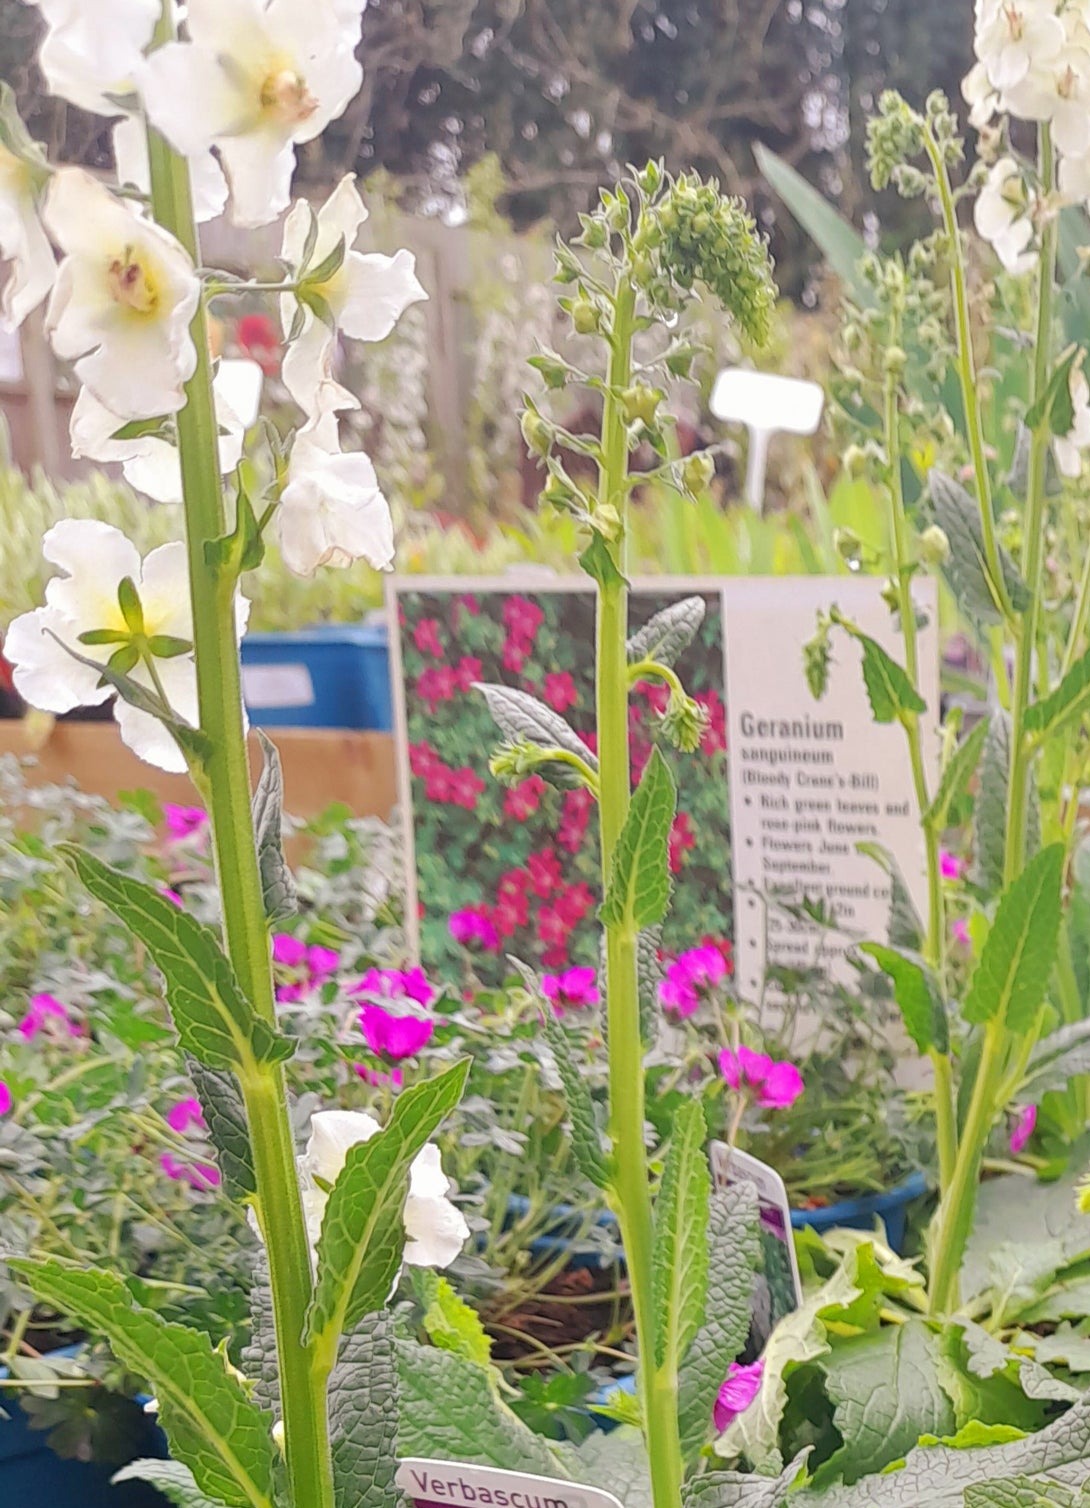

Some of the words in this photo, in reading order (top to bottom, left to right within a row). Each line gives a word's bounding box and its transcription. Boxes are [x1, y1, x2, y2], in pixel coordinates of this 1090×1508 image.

[740, 711, 844, 740] Geranium
[741, 746, 834, 766] sanguineum
[743, 768, 790, 789] (Bloody
[761, 793, 790, 810] Rich
[795, 799, 832, 815] green
[838, 799, 880, 815] leaves
[885, 801, 910, 816] and
[761, 836, 813, 853] Flowers
[819, 839, 850, 856] June
